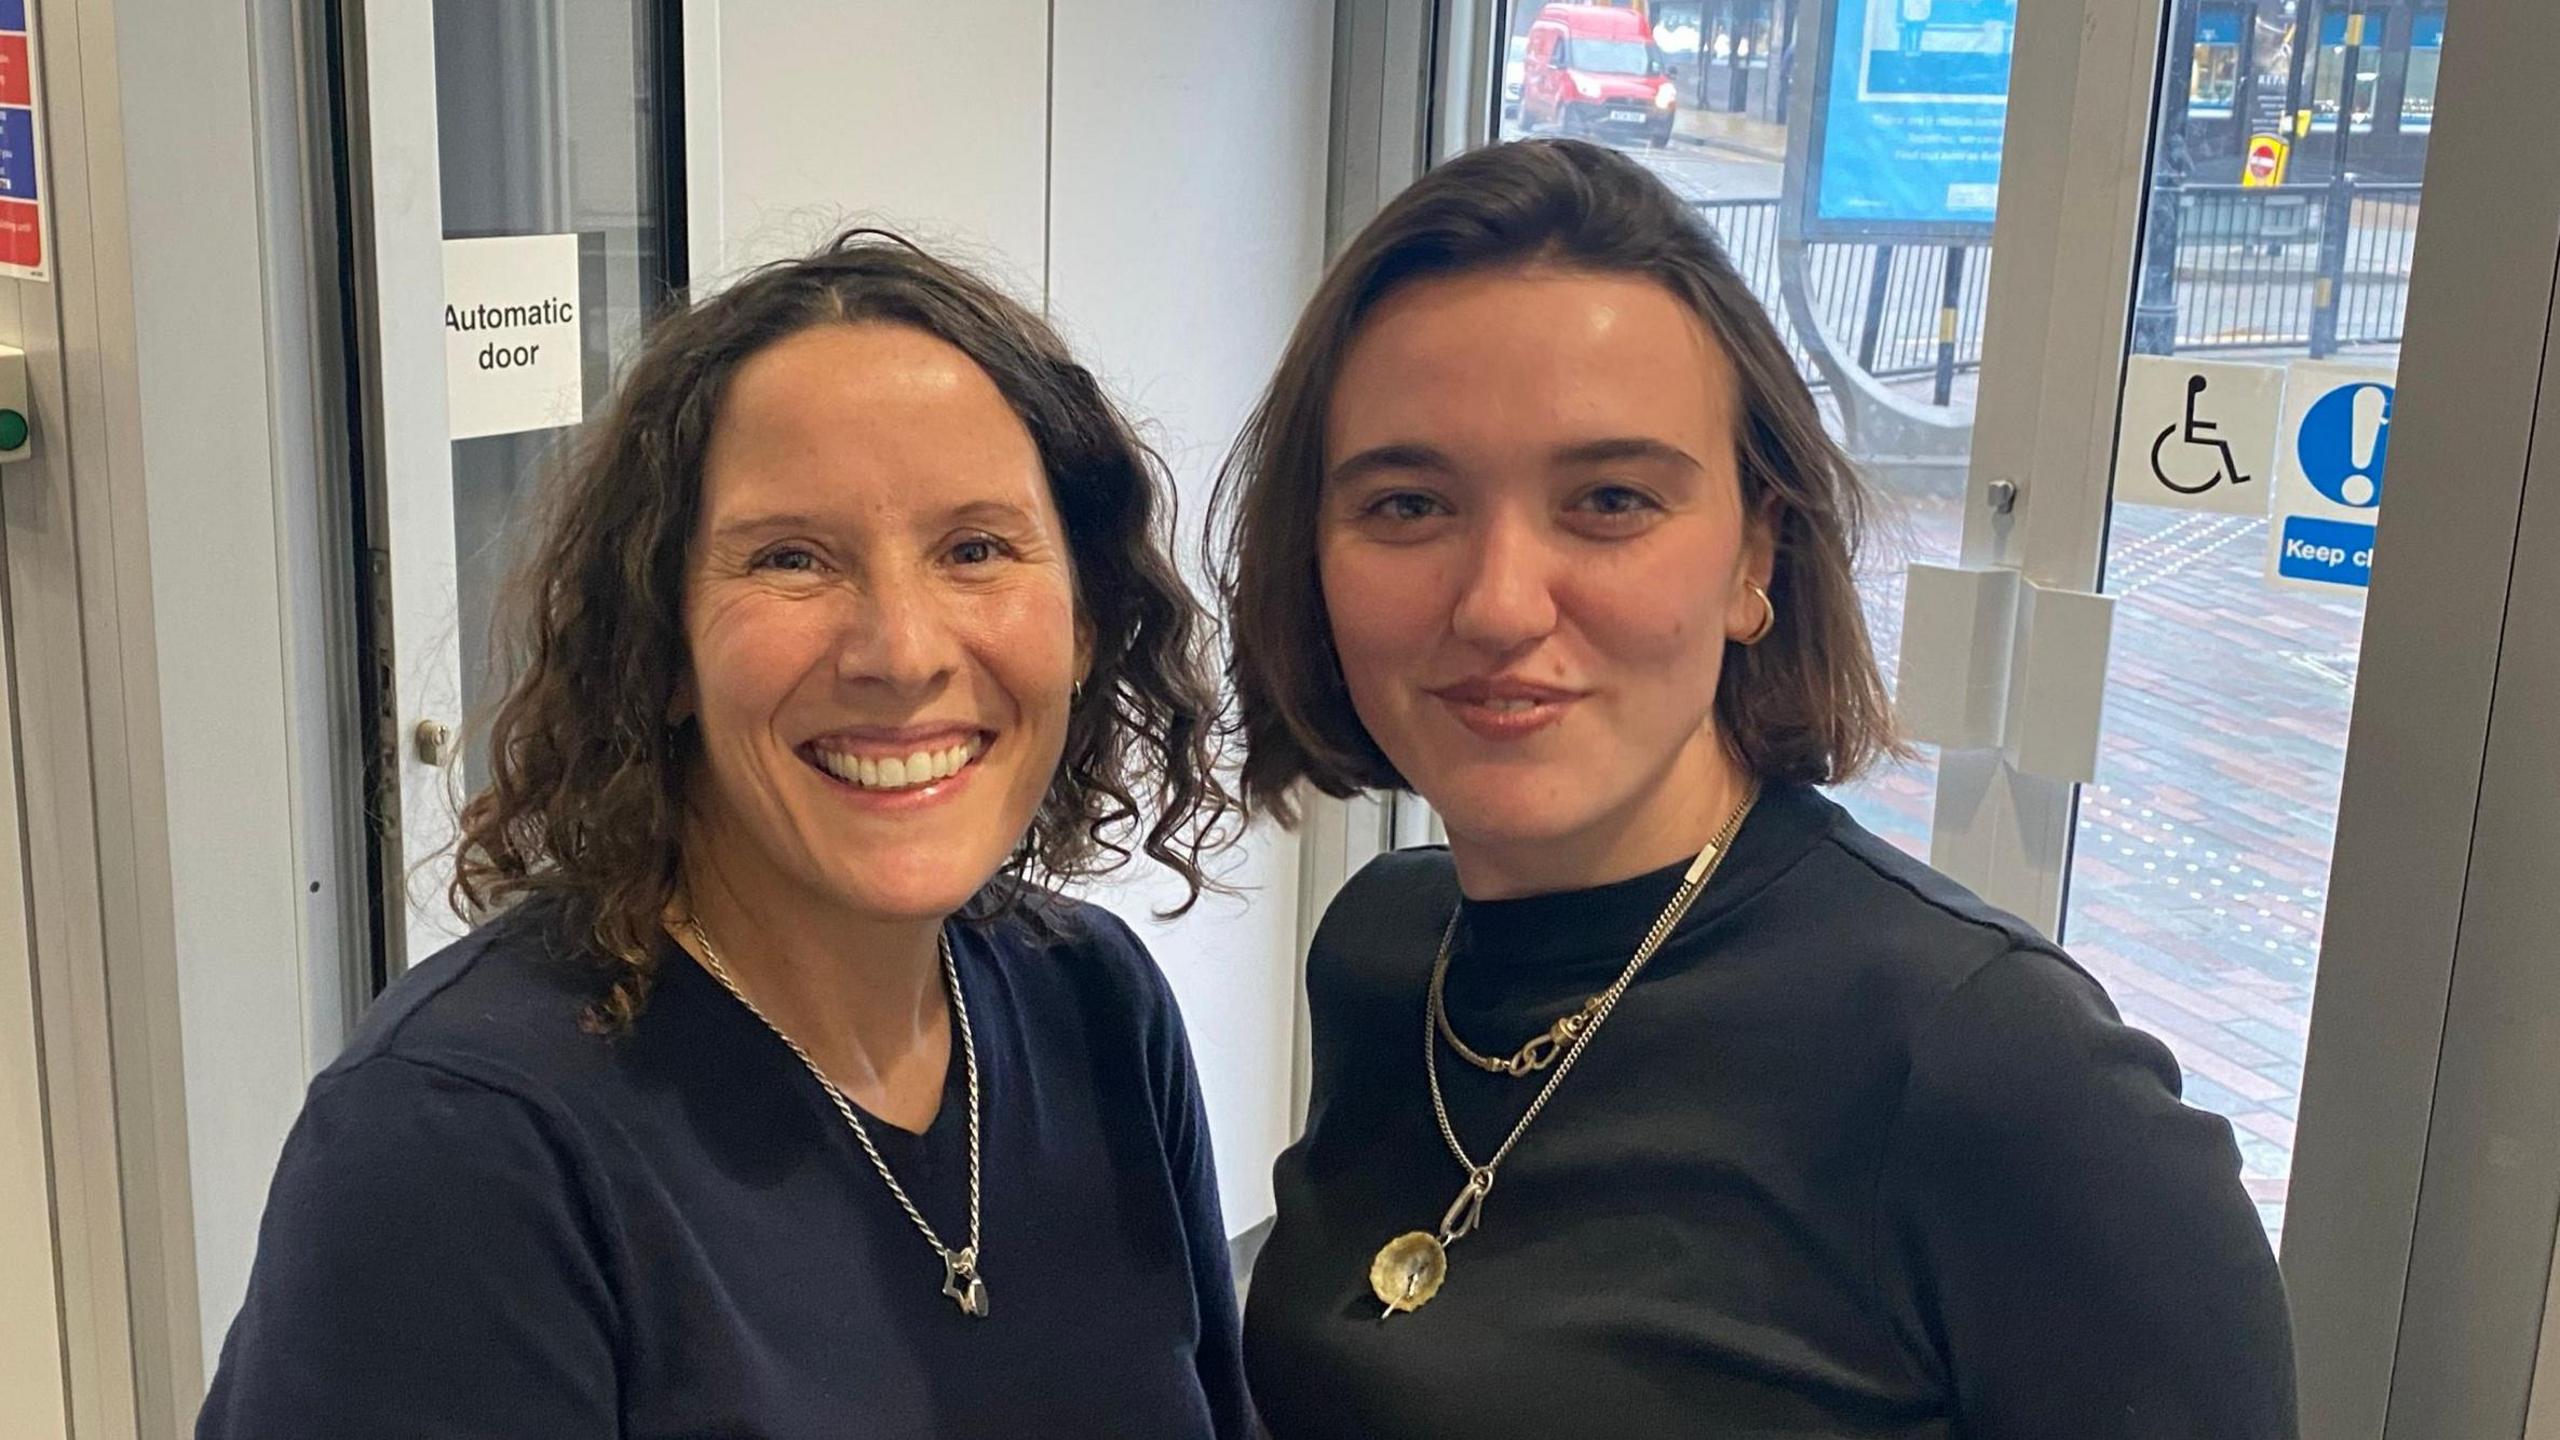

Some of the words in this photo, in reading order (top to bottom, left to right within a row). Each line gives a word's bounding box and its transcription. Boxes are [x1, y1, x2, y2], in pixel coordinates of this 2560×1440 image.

[445, 297, 573, 332] Automatic
[478, 342, 540, 370] door
[2286, 538, 2346, 568] Keep
